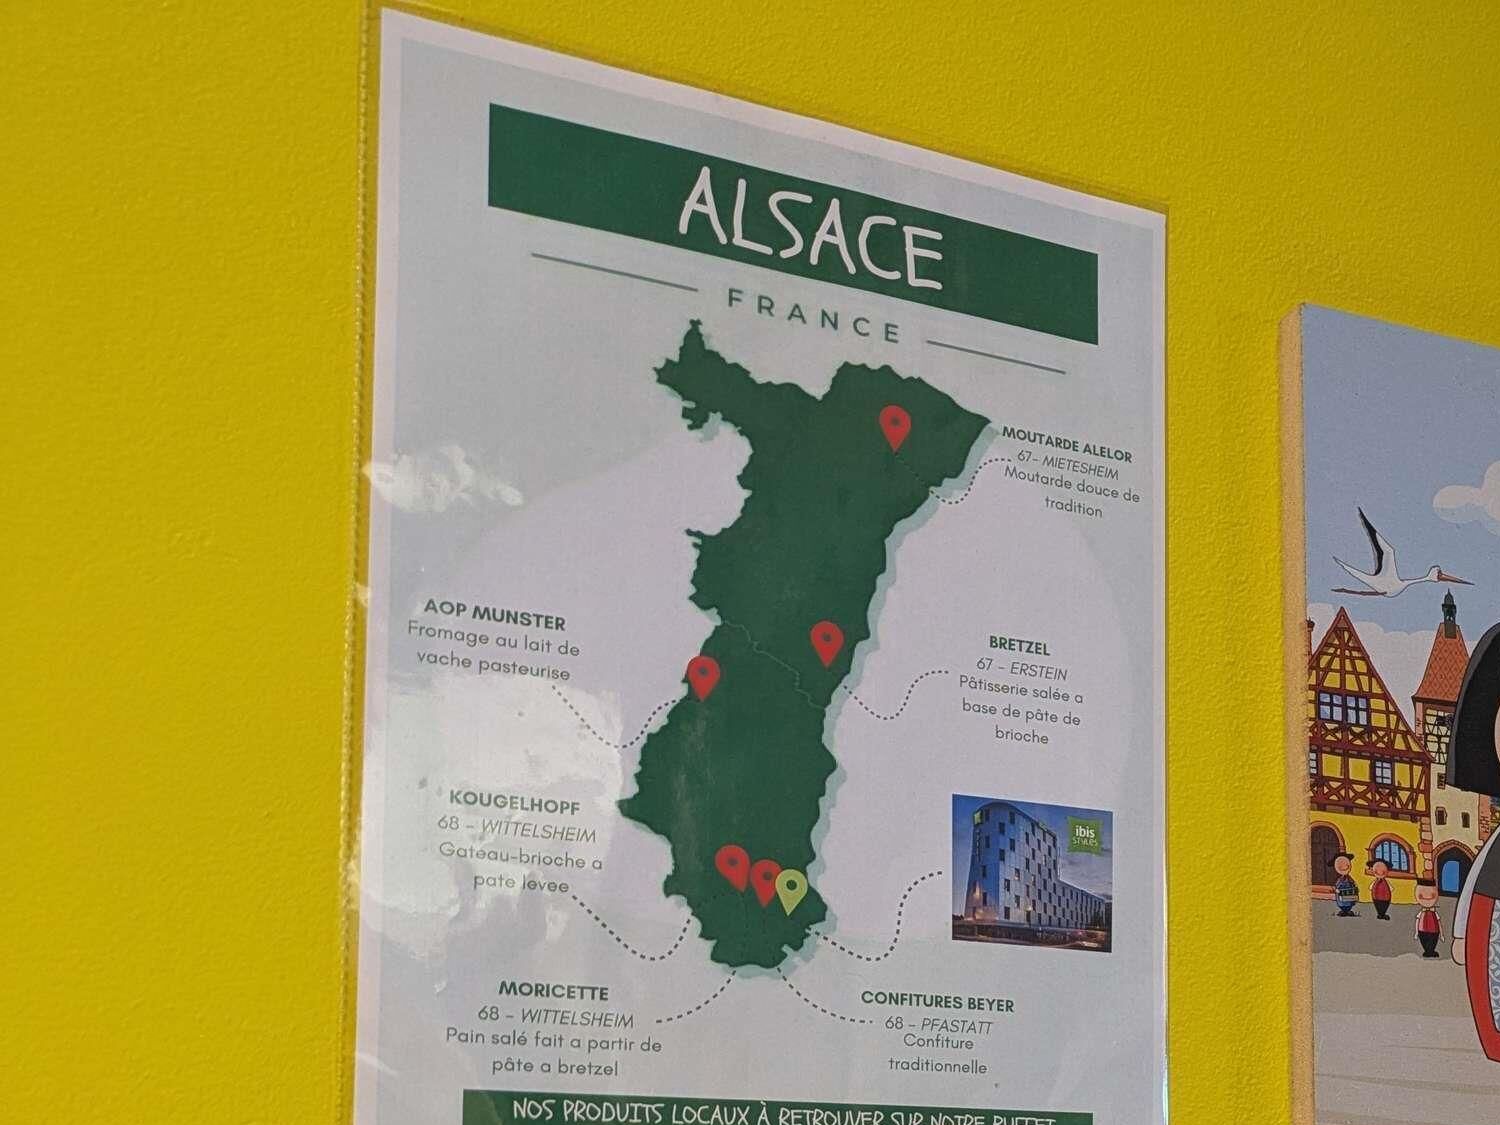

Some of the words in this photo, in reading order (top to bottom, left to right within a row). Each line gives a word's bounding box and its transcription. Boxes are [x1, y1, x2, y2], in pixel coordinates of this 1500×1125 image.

[679, 166, 943, 290] ALSACE
[728, 288, 899, 343] FRANCE
[1002, 426, 1079, 451] MOUTARDE
[1083, 443, 1133, 463] ALELOR
[1042, 455, 1119, 480] MIETESHEIM
[1004, 466, 1071, 490] Moutarde
[1077, 479, 1119, 498] douce
[1123, 490, 1140, 502] de
[1045, 496, 1103, 518] tradition
[424, 598, 467, 616] AOP
[472, 605, 567, 631] MUNSTER
[408, 620, 489, 647] Fromage
[496, 636, 518, 649] au
[524, 635, 551, 653] lait
[558, 640, 580, 656] de
[989, 635, 1051, 656] BRETZEL
[417, 651, 472, 668] vache
[478, 659, 571, 680] pasteurise
[977, 657, 993, 671] 67
[1010, 661, 1068, 681] ERSTEIN
[960, 674, 1028, 697] Pâtisserie
[1032, 686, 1070, 702] salée
[1075, 694, 1083, 704] a
[962, 697, 997, 715] base
[1002, 704, 1021, 718] de
[1026, 709, 1058, 724] pâte
[1063, 712, 1081, 726] de
[995, 725, 1049, 744] brioche
[450, 789, 581, 816] KOUGELHOPF
[437, 814, 460, 831] 68
[481, 818, 597, 843] WITTELSHEIM
[1075, 825, 1096, 839] ibis
[439, 841, 586, 869] Gateau-brioche
[592, 859, 603, 870] a
[473, 874, 516, 890] pate
[522, 874, 570, 893] levee
[498, 980, 609, 1001] MORICETTE
[861, 990, 963, 1009] CONFITURES
[967, 997, 1015, 1013] BEYER
[478, 1005, 500, 1021] 68
[521, 1007, 634, 1029] WITTELSHEIM
[885, 1016, 904, 1030] 68
[921, 1017, 994, 1035] PFASTATT
[446, 1027, 485, 1044] Pain
[491, 1030, 527, 1047] salé
[534, 1031, 564, 1048] fait
[570, 1037, 581, 1048] a
[587, 1036, 635, 1053] partir
[640, 1035, 662, 1052] de
[903, 1033, 975, 1050] Confiture
[492, 1057, 534, 1075] pâte
[540, 1062, 551, 1073] a
[558, 1057, 619, 1077] bretzel
[888, 1056, 988, 1075] traditionnelle
[513, 1097, 556, 1121] NOS
[563, 1100, 665, 1123] PRODUITS
